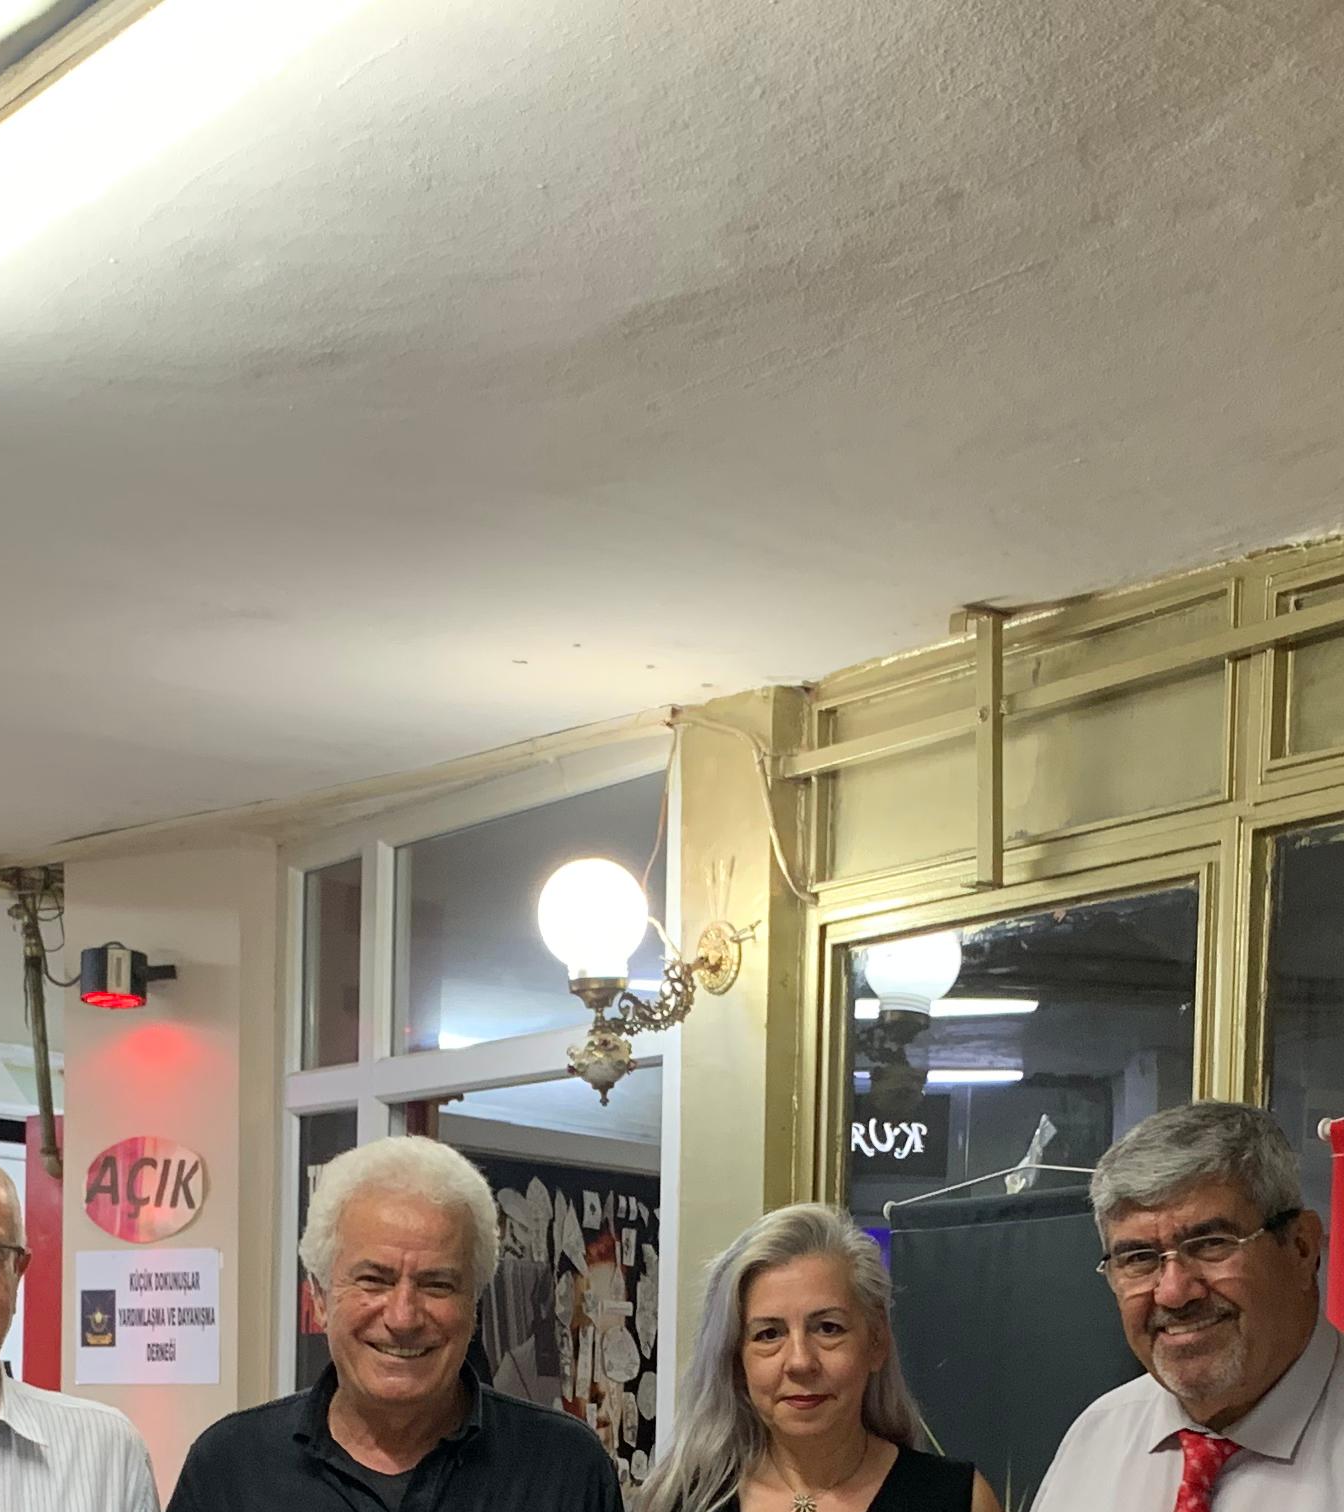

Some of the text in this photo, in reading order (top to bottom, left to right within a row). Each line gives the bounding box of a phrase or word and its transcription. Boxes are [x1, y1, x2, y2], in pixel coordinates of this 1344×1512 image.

[85, 1155, 200, 1219] AÇIK
[129, 1268, 200, 1297] KÜÇÜK DOKUNUŞLAR
[118, 1307, 216, 1332] YARDIMLAŞMA VE DAYANIŞMA
[146, 1338, 177, 1362] DERNEĞİ
